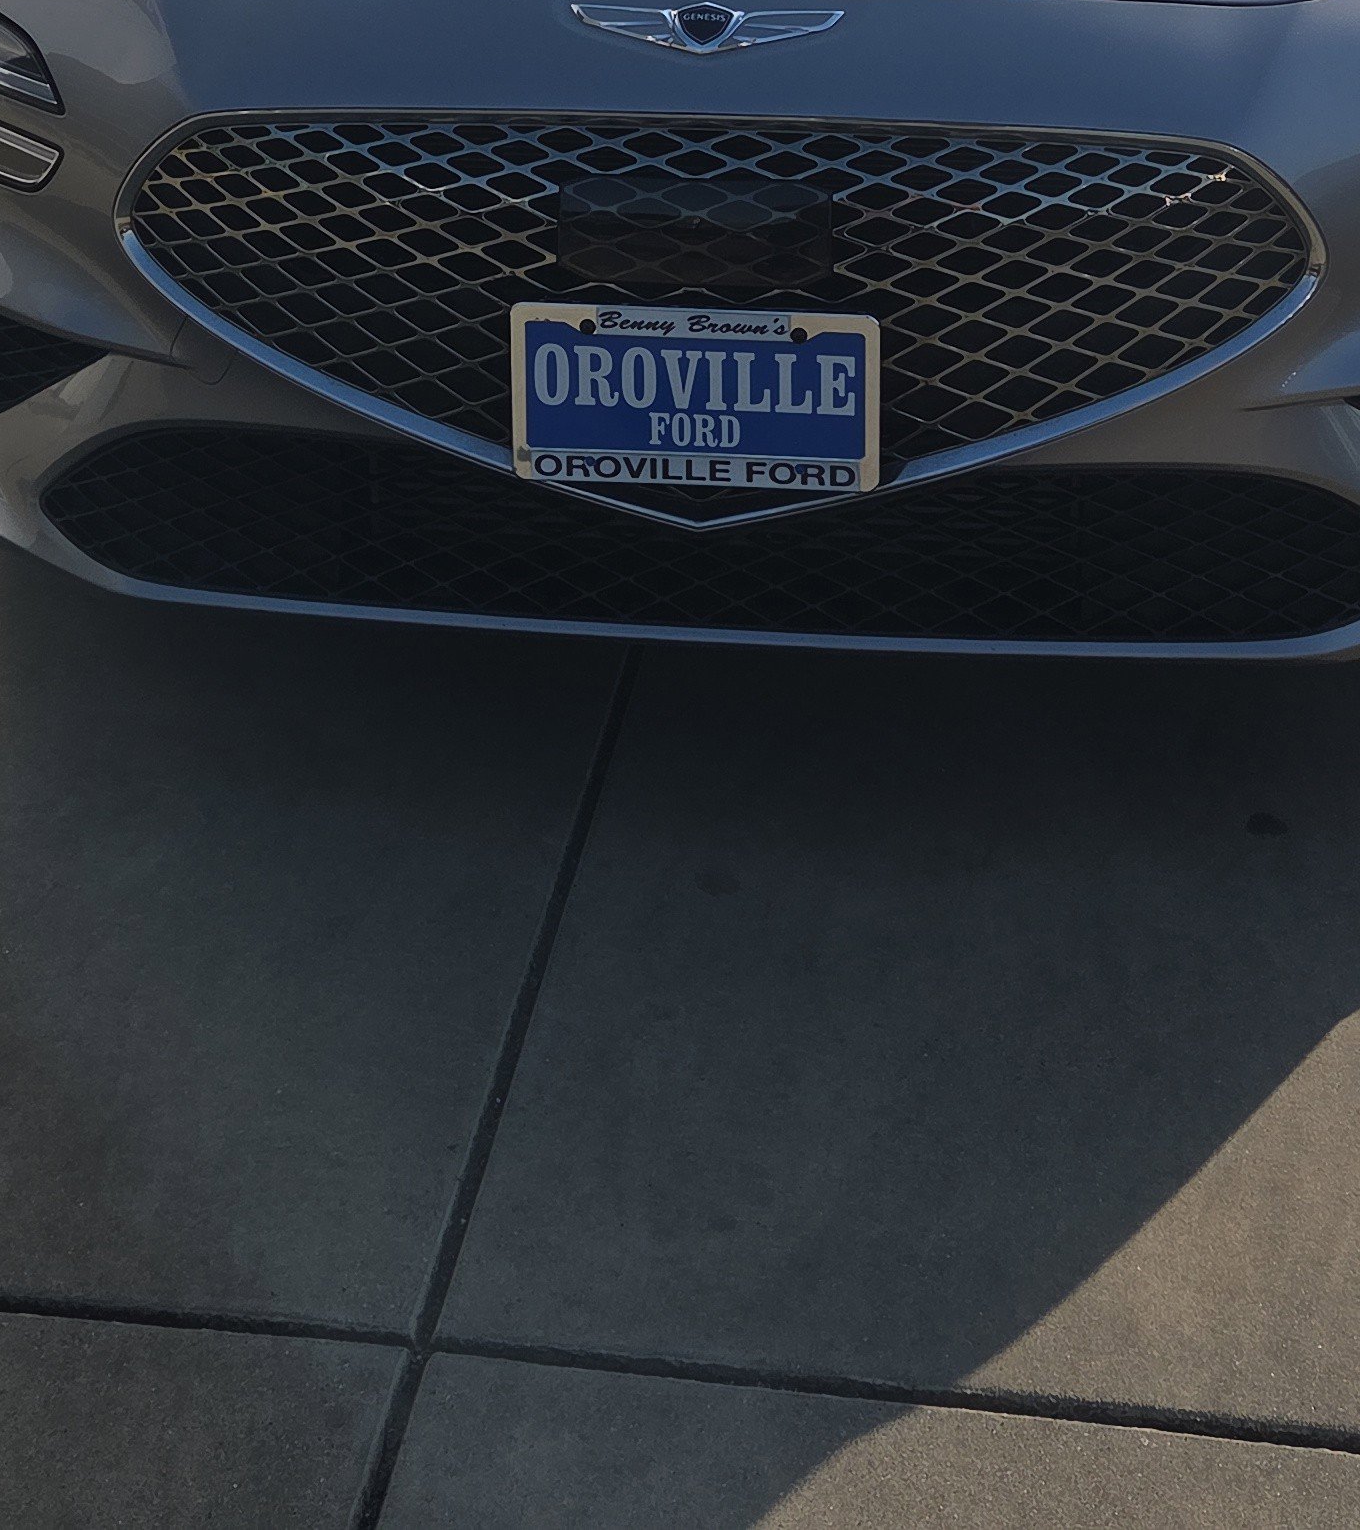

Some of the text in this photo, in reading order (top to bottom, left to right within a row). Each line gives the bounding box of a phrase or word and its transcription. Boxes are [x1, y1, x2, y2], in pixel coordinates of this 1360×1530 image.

[683, 12, 727, 22] GENESIS
[597, 311, 789, 337] Benny Brown's
[533, 342, 857, 418] OROVILLE
[648, 411, 741, 449] FORD
[533, 453, 857, 488] OROVILLE FORD
